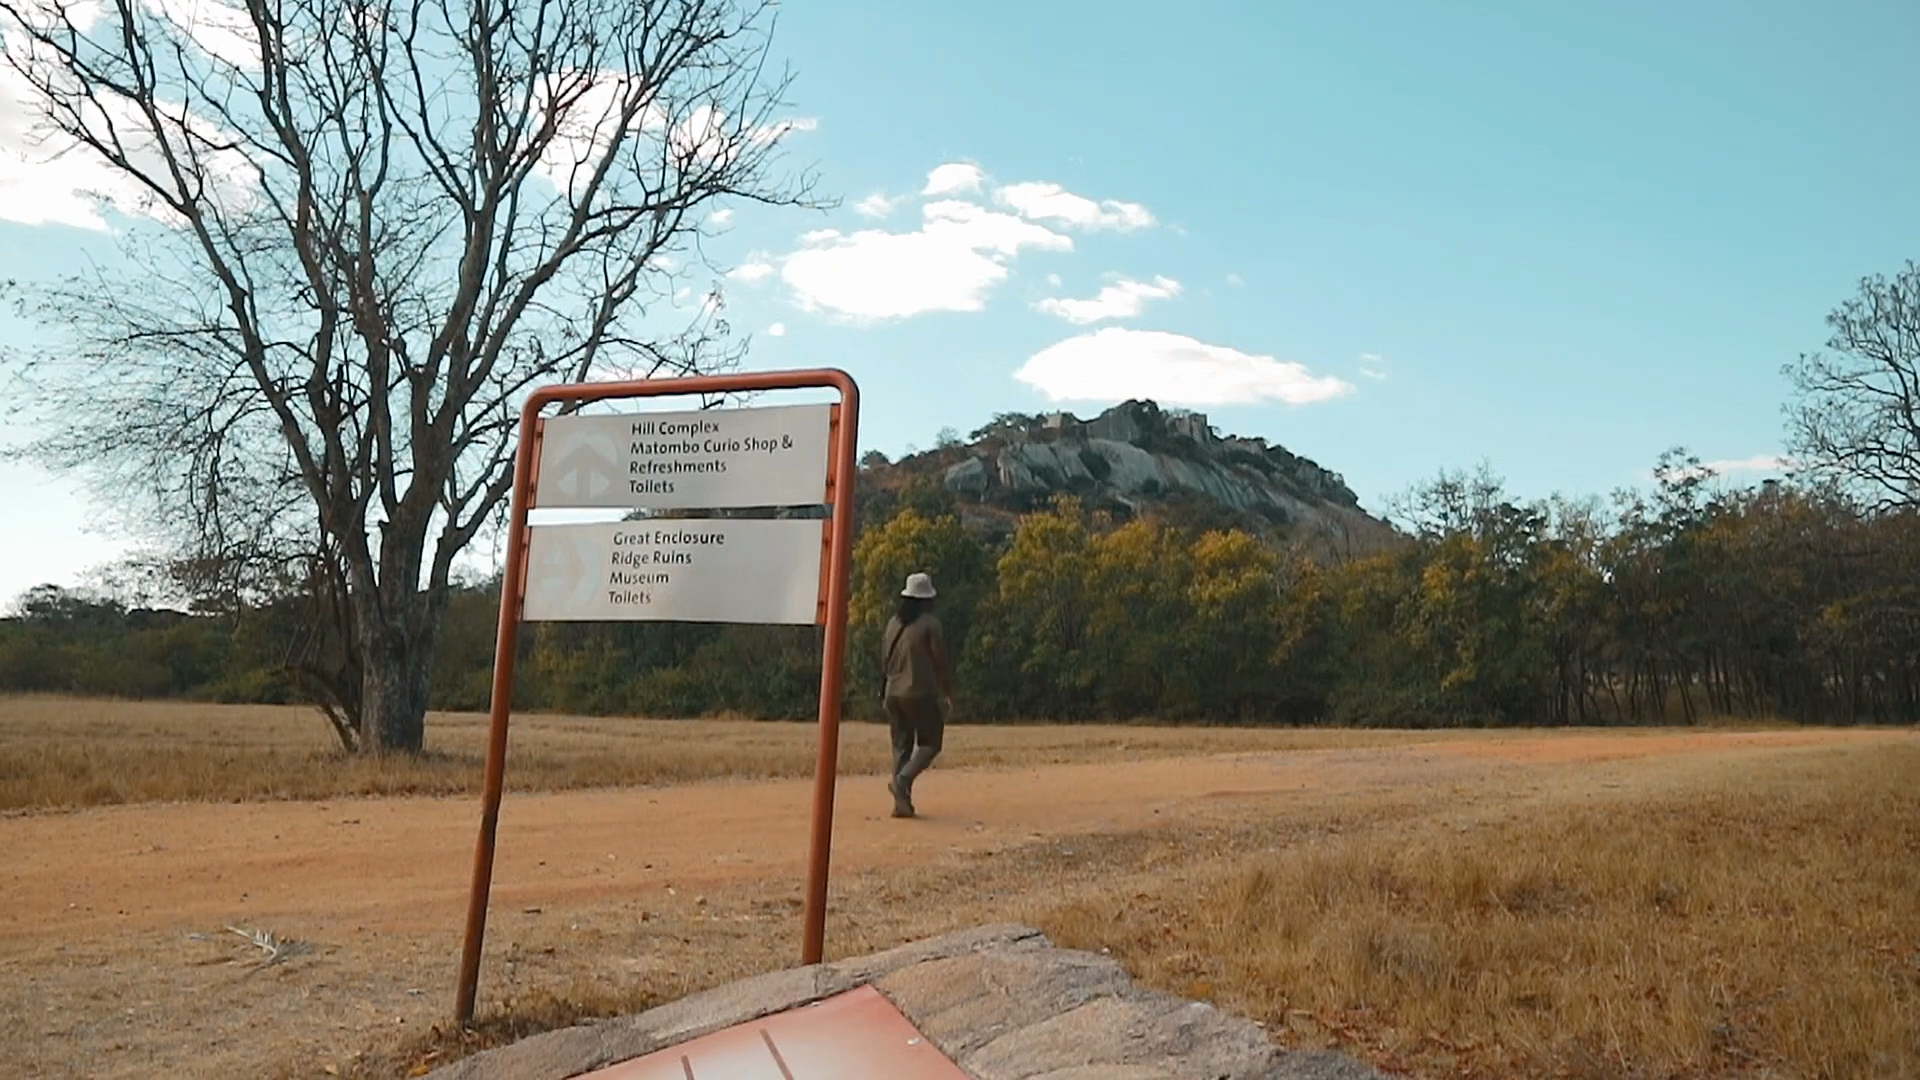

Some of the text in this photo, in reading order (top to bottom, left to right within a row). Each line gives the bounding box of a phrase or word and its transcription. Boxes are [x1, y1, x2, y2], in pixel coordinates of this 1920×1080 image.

[631, 420, 720, 438] Hill Complex
[630, 434, 793, 455] Matombo Curio Shop &
[629, 459, 727, 474] Refreshments
[629, 480, 675, 494] Toilets
[613, 528, 725, 546] Great Enclosure
[611, 550, 692, 569] Ridge Ruins
[609, 571, 669, 585] Museum
[608, 590, 652, 605] Toilets
